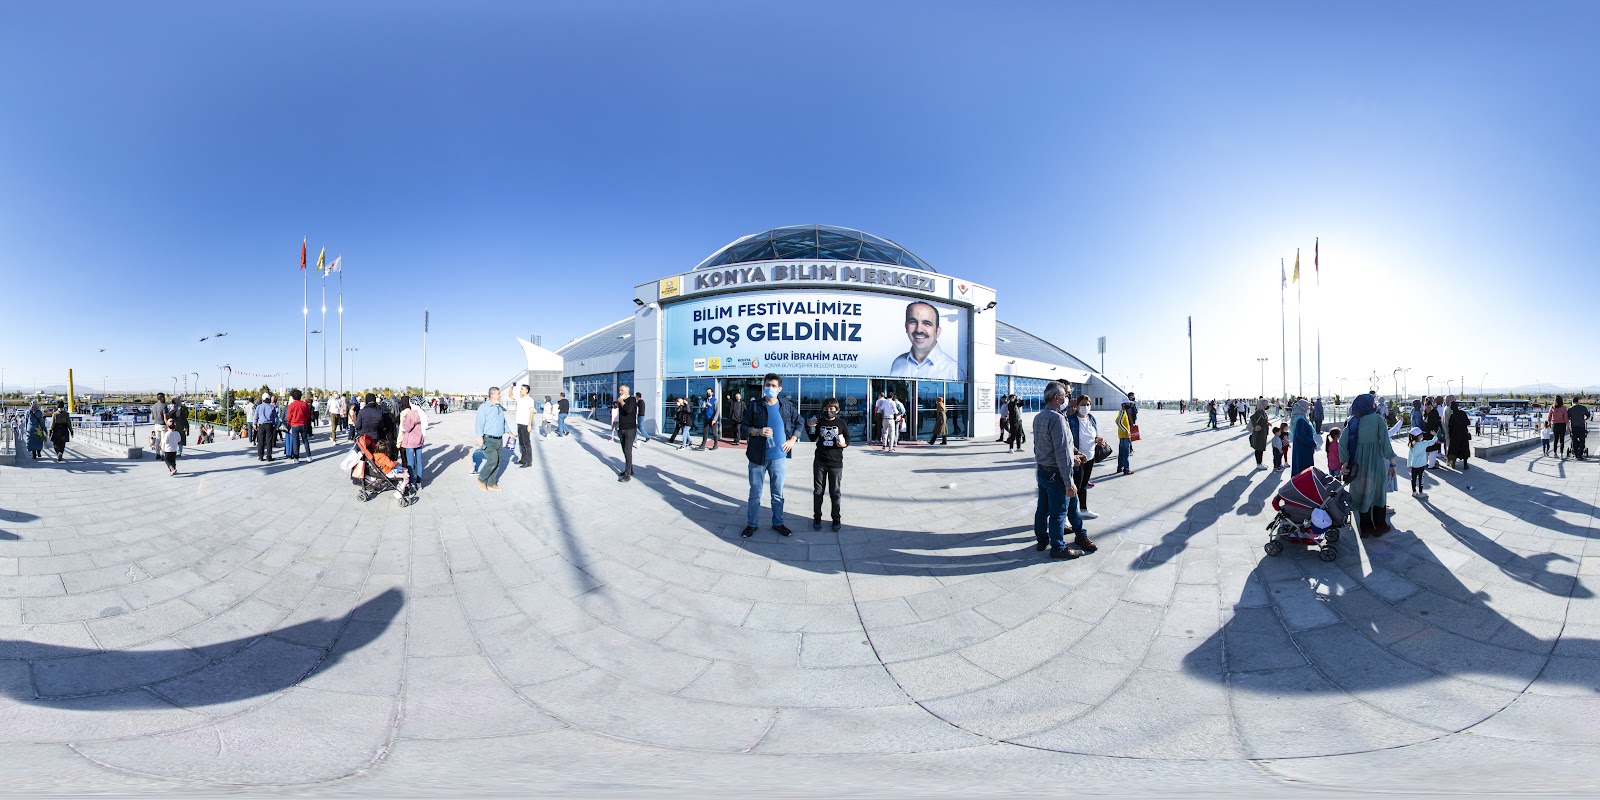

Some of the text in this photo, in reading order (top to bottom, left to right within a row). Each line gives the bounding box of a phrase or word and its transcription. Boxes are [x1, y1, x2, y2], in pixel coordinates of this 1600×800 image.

[695, 267, 766, 290] KONYA
[842, 266, 935, 292] MERKEZİ
[693, 300, 862, 322] BİLİM FESTİVALİMİZE
[693, 319, 862, 349] HOŞ GELDİNİZ
[764, 351, 858, 361] UĞUR İBRAHİM ALTAY
